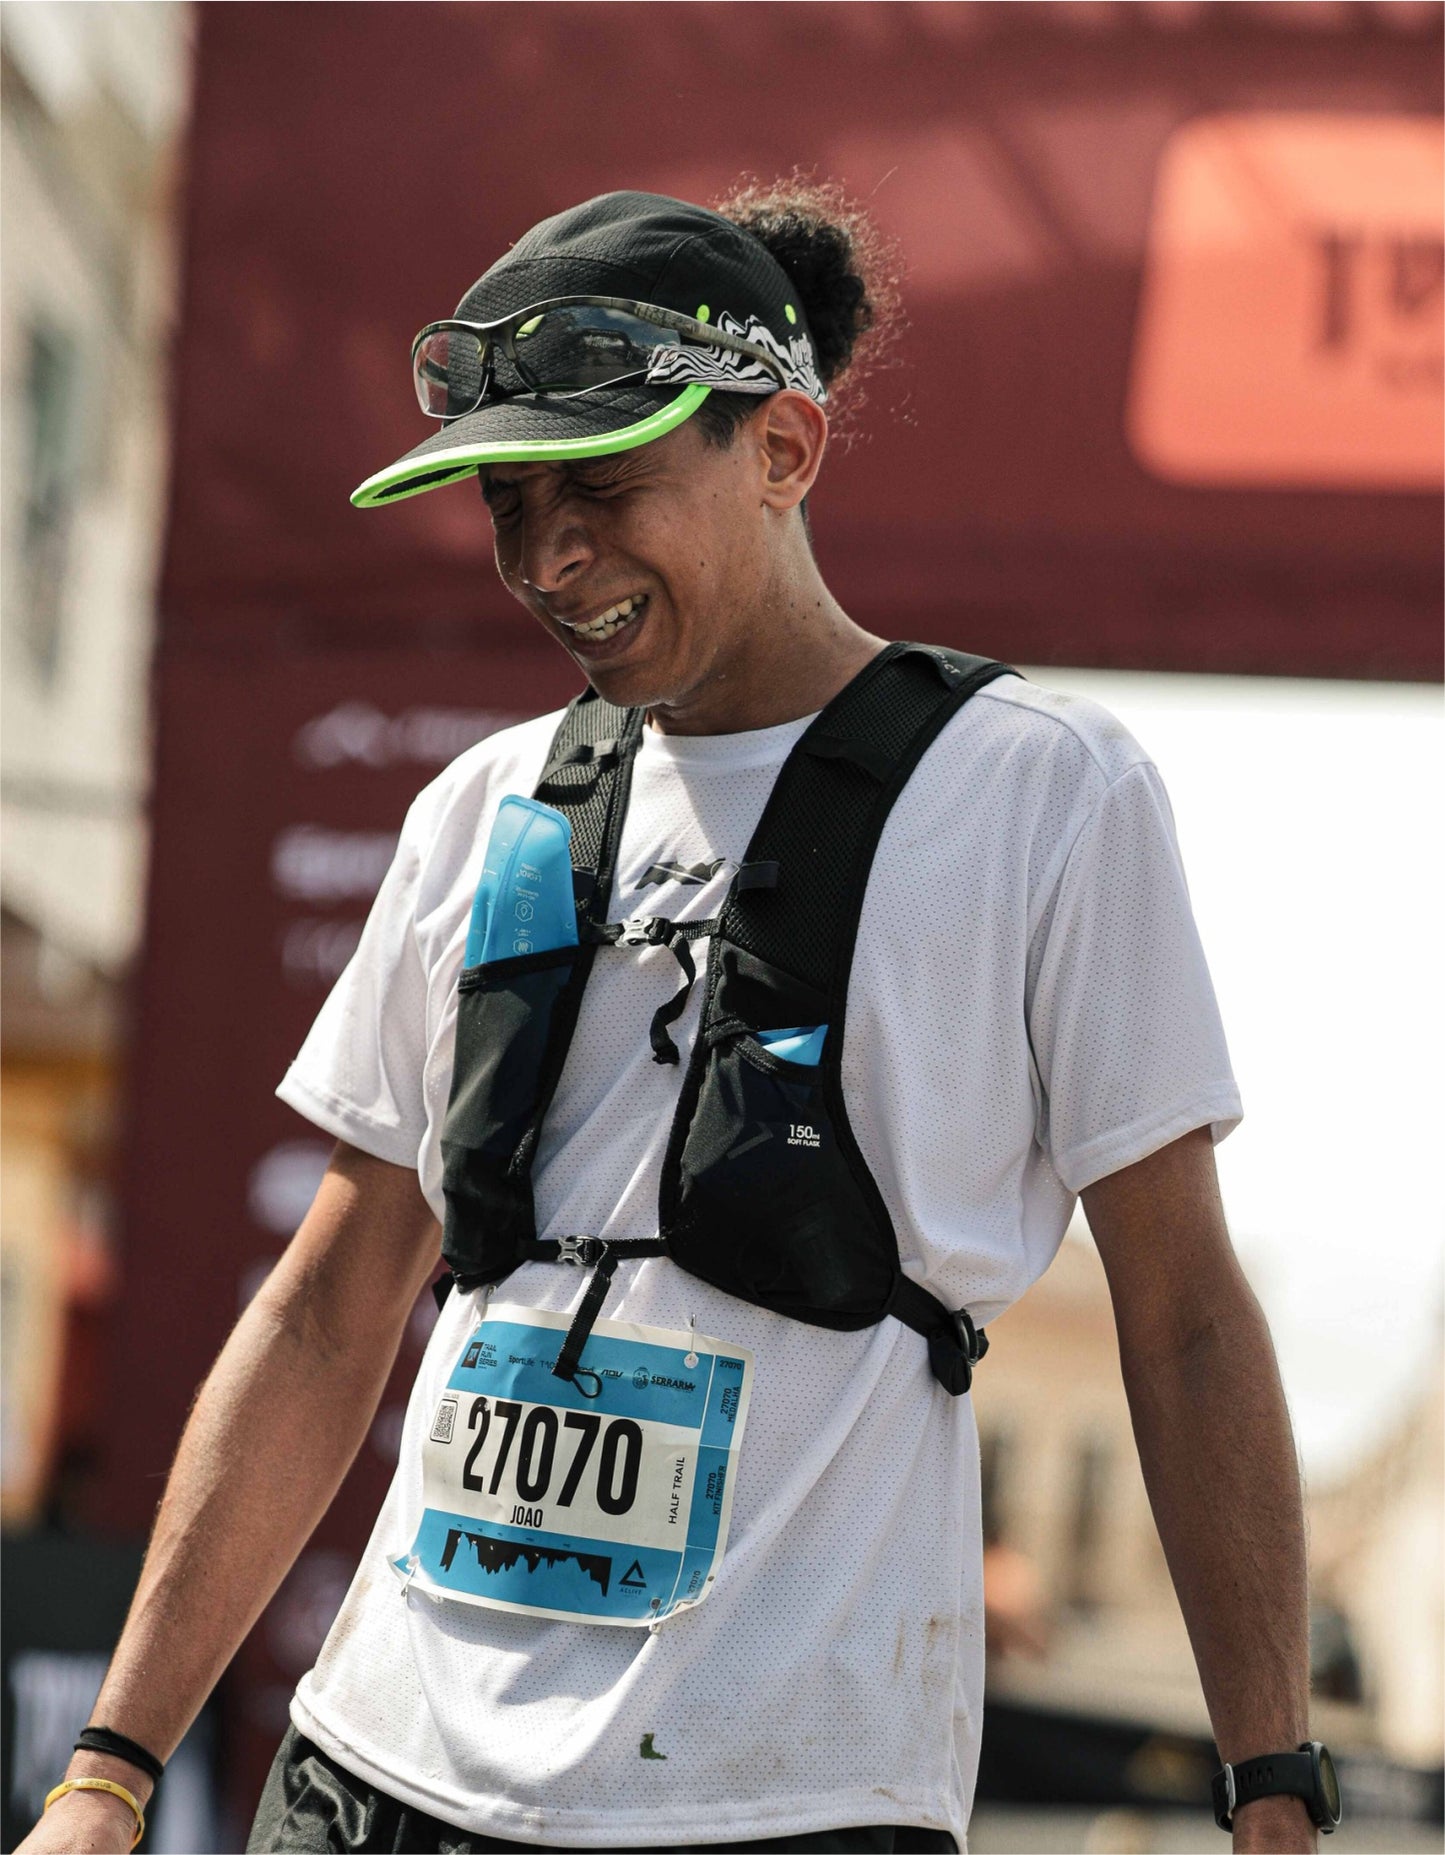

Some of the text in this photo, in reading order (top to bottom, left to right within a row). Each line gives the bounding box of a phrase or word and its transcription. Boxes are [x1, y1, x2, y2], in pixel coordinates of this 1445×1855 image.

[803, 1139, 820, 1147] FLASK
[478, 1357, 497, 1367] SERIES
[719, 1360, 742, 1370] 27070
[720, 1387, 732, 1415] 27070
[727, 1386, 741, 1423] MEDALHA
[463, 1396, 643, 1516] 27070
[668, 1457, 685, 1524] HALF TRAIL
[705, 1472, 717, 1500] 27070
[712, 1465, 727, 1515] KIT FINISHER
[510, 1505, 544, 1528] JOAO
